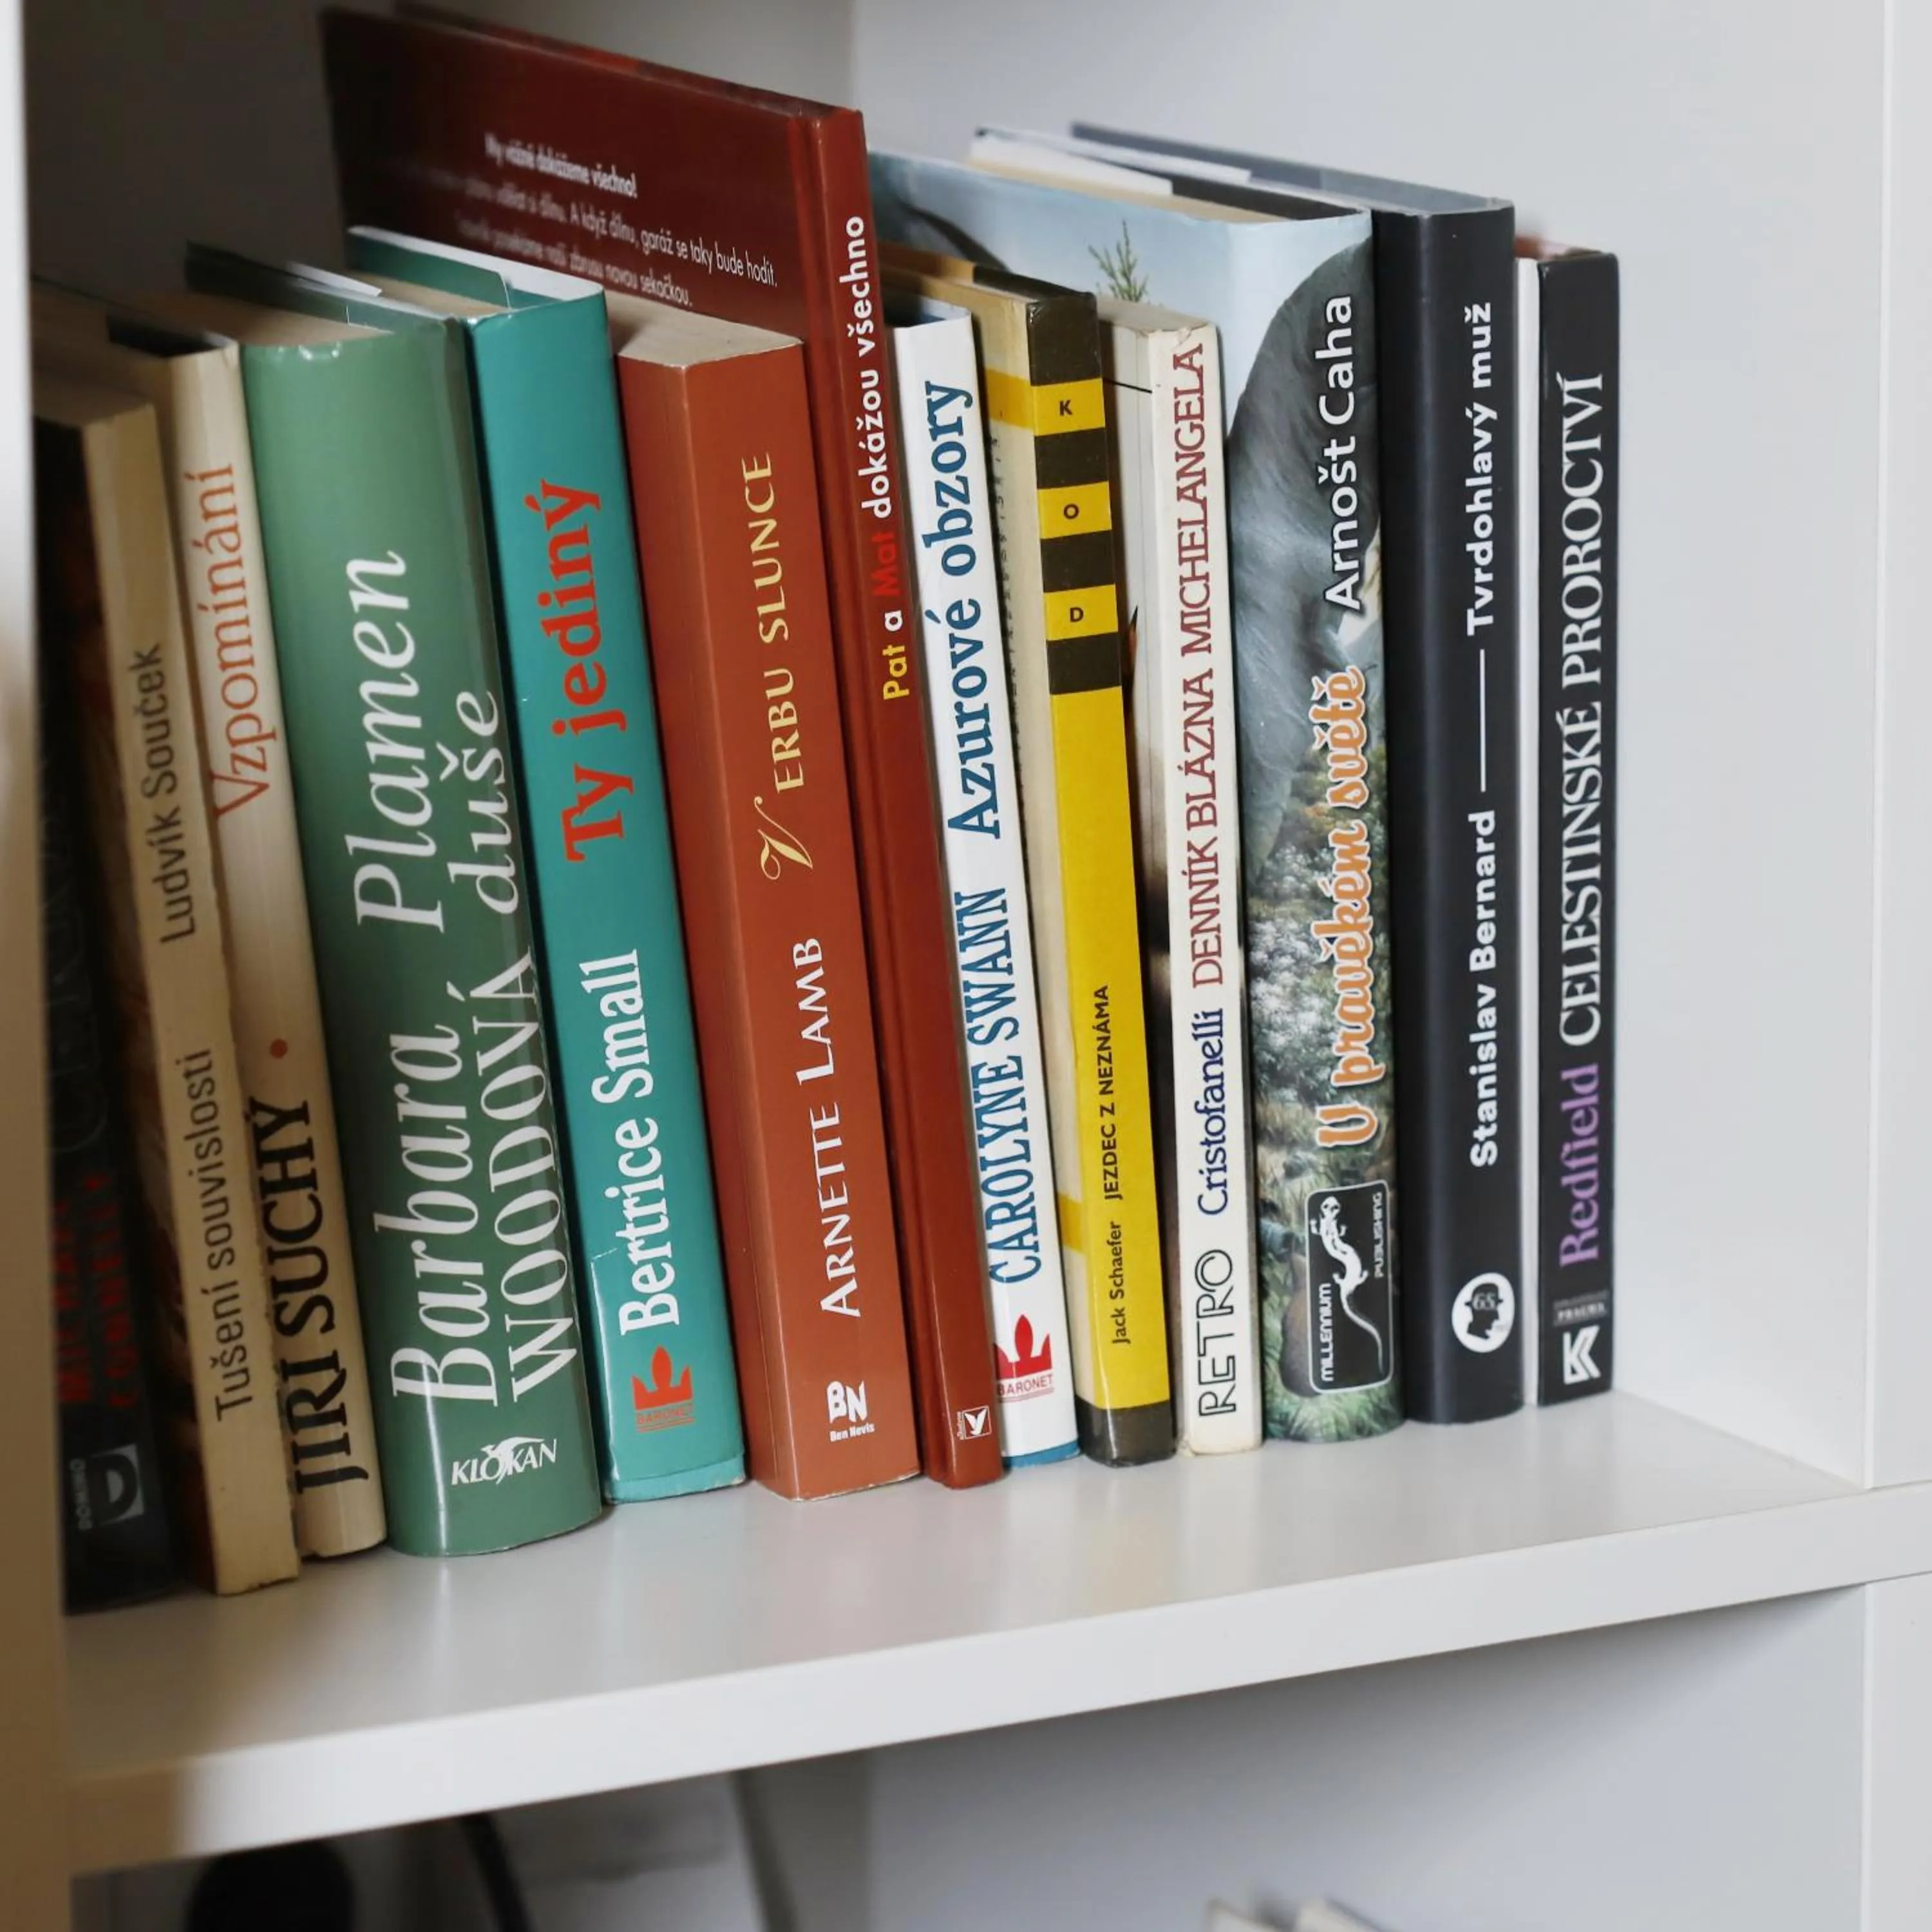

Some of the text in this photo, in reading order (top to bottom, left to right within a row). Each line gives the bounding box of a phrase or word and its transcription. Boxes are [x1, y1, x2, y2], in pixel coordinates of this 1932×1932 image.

[639, 267, 693, 307] sekačkou.
[641, 227, 674, 256] garáž
[676, 240, 688, 260] se
[690, 236, 713, 274] taky
[715, 241, 744, 276] bude
[745, 249, 778, 287] hodit.
[742, 452, 789, 643] SLUNCE
[838, 216, 909, 699] Pat a Mat dokážou všechno
[1314, 296, 1361, 611] Arnošt Caha
[1556, 372, 1604, 690] PROROCTVÍ
[185, 463, 277, 819] Vzpomínání
[764, 668, 804, 794] ERBU
[1309, 665, 1368, 808] světě
[1464, 302, 1499, 1168] Stanislav Bernard Tvrdohlavý muž
[345, 550, 498, 1406] Barbara Plamen
[525, 478, 679, 1336] Bertrice Small Ty jediný
[922, 381, 1041, 1283] CAROLYNE SWANN Azurové obzory
[1172, 343, 1236, 1416] RETRO Cristofanelli DENNÍK BLÁZNA MICHELANGELA
[1312, 820, 1385, 1086] pravěkém
[1555, 701, 1602, 1046] CELESTINSKÉ
[129, 641, 254, 1421] Tušení souvislosti Ludvík Souček
[436, 690, 578, 1403] WOODOVÁ duše
[793, 937, 837, 1085] LAMB
[1093, 985, 1132, 1345] Jack Schaefer JEZDEC Z NEZNÁMA
[1560, 1062, 1600, 1269] Redfield
[810, 1102, 860, 1318] ARNETTE
[451, 1437, 557, 1486] KLOKAN
[826, 1380, 867, 1424] BN
[997, 1374, 1053, 1396] BARONET
